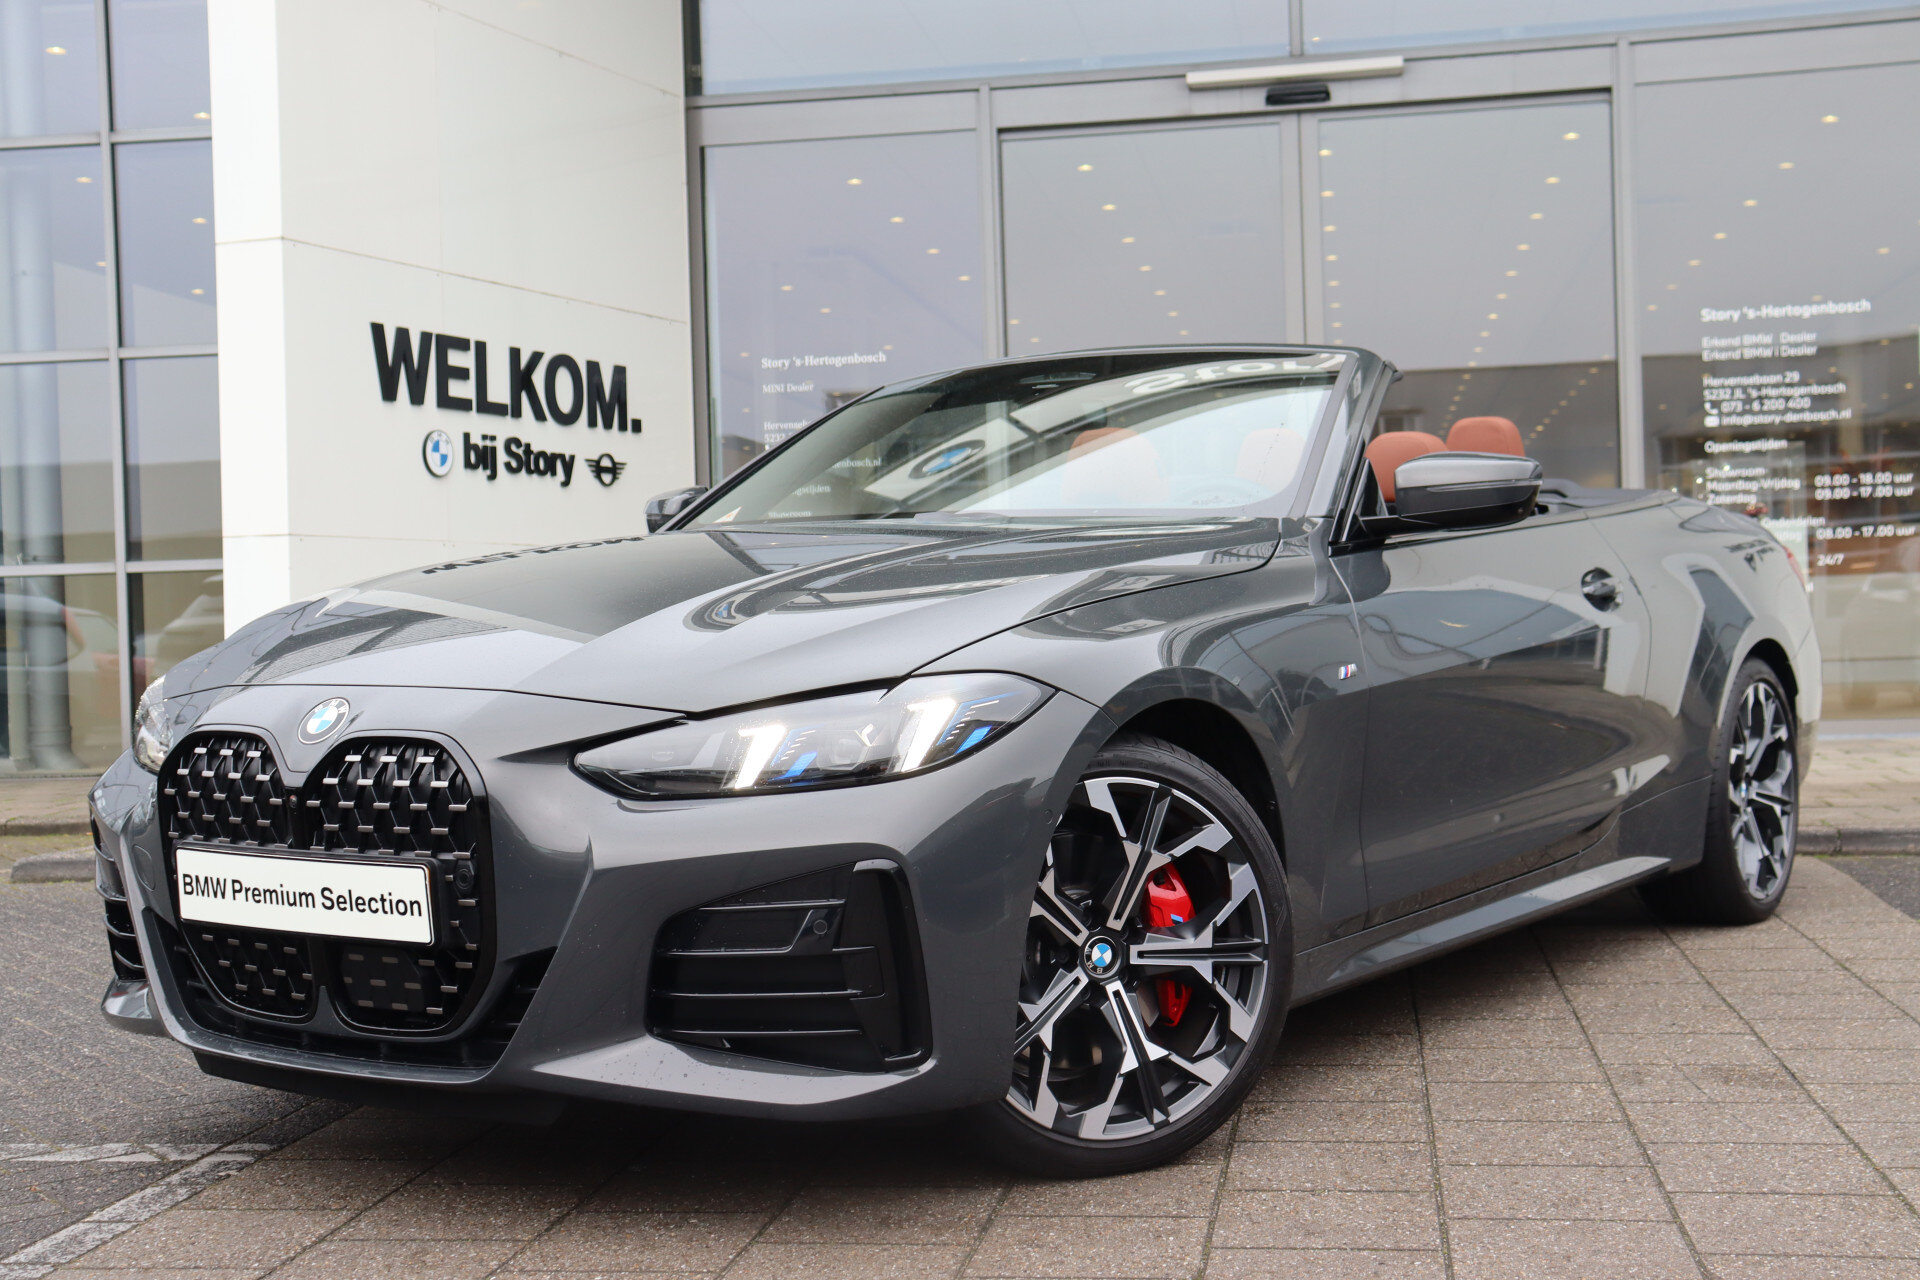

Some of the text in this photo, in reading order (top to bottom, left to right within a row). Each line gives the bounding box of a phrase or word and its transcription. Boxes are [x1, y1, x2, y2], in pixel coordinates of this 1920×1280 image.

[1700, 299, 1871, 323] Story 's-Hertogenbosch
[1702, 332, 1817, 348] Erkend BMW Dealer
[761, 351, 886, 370] Story 's-Hertogenbosch
[1702, 349, 1741, 361] Erkend
[1743, 347, 1773, 359] BMW
[1781, 345, 1817, 357] Dealer
[370, 321, 642, 434] WELKOM.
[1784, 371, 1800, 383] 29
[762, 380, 814, 393] MINI Dealer
[1703, 388, 1731, 400] 5232
[1747, 382, 1846, 398] 's-Hertogenbosch
[1720, 400, 1743, 413] 073
[1752, 400, 1761, 411] 6
[1762, 398, 1786, 411] 200
[1786, 396, 1811, 409] 400
[1704, 439, 1788, 454] Openingstijden
[463, 432, 576, 488] bij Story
[1814, 474, 1850, 487] 09.00
[1859, 471, 1892, 484] 18.00
[1893, 473, 1914, 484] uur
[1815, 487, 1851, 500] 09.00
[1894, 486, 1915, 497] uur
[1895, 526, 1916, 537] uur
[183, 873, 423, 917] BMW Premium Selection
